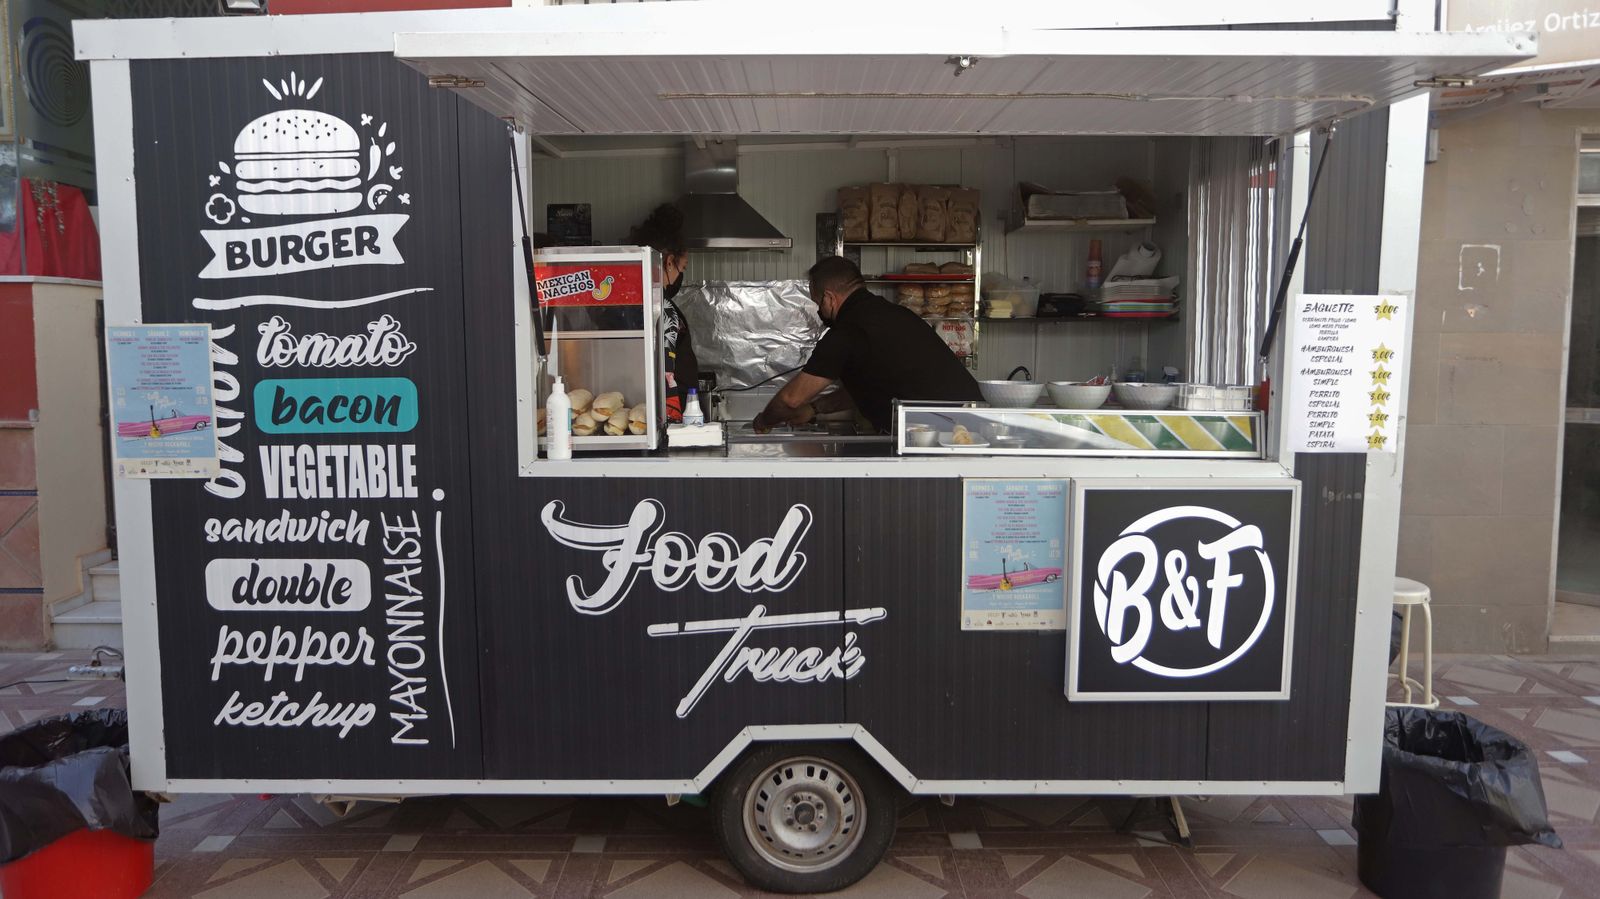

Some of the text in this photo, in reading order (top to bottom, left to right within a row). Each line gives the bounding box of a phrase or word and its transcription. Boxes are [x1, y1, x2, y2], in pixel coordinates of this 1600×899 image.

[1464, 9, 1600, 32] üez Ortiz
[226, 226, 381, 271] BURGER
[537, 271, 590, 290] MEXICAN
[543, 280, 594, 299] NACHOS
[1302, 302, 1354, 313] BAGUETTE
[256, 314, 417, 368] tomato
[1301, 344, 1354, 353] HAMBURGUESA
[1310, 355, 1343, 363] ESPECIAL
[1300, 368, 1353, 376] HAMBURGUESA
[1312, 378, 1339, 386] SIMPLE
[271, 385, 402, 426] bacon
[1308, 390, 1341, 398] PERRITO
[1308, 400, 1341, 408] ESPECIAL
[1306, 411, 1339, 419] PERRITO
[1306, 440, 1336, 448] ESPIRAL
[1308, 430, 1335, 439] PATATA
[259, 444, 418, 499] VEGETABLE
[204, 509, 370, 546] sandwich
[541, 498, 813, 615] Food
[232, 562, 352, 609] double
[1097, 524, 1264, 664] B&F
[380, 510, 429, 744] MAYONNAISE
[210, 625, 376, 682] pepper
[647, 604, 887, 718] Truck
[214, 691, 376, 739] ketchup
